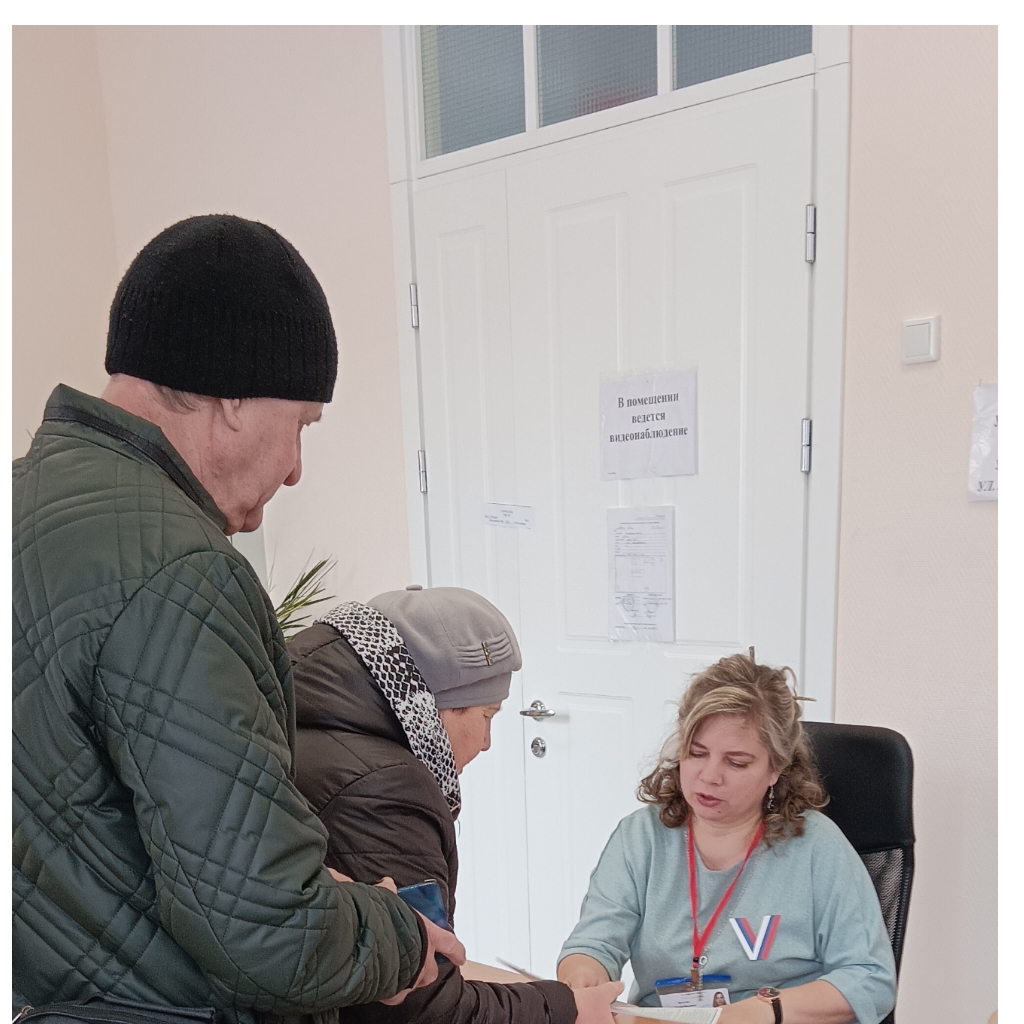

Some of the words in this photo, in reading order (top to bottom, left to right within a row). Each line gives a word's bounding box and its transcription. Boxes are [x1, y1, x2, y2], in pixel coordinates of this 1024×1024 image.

[618, 397, 625, 409] В
[627, 393, 679, 408] помещении
[632, 412, 666, 424] ведется
[609, 427, 688, 443] видеонаблюдение
